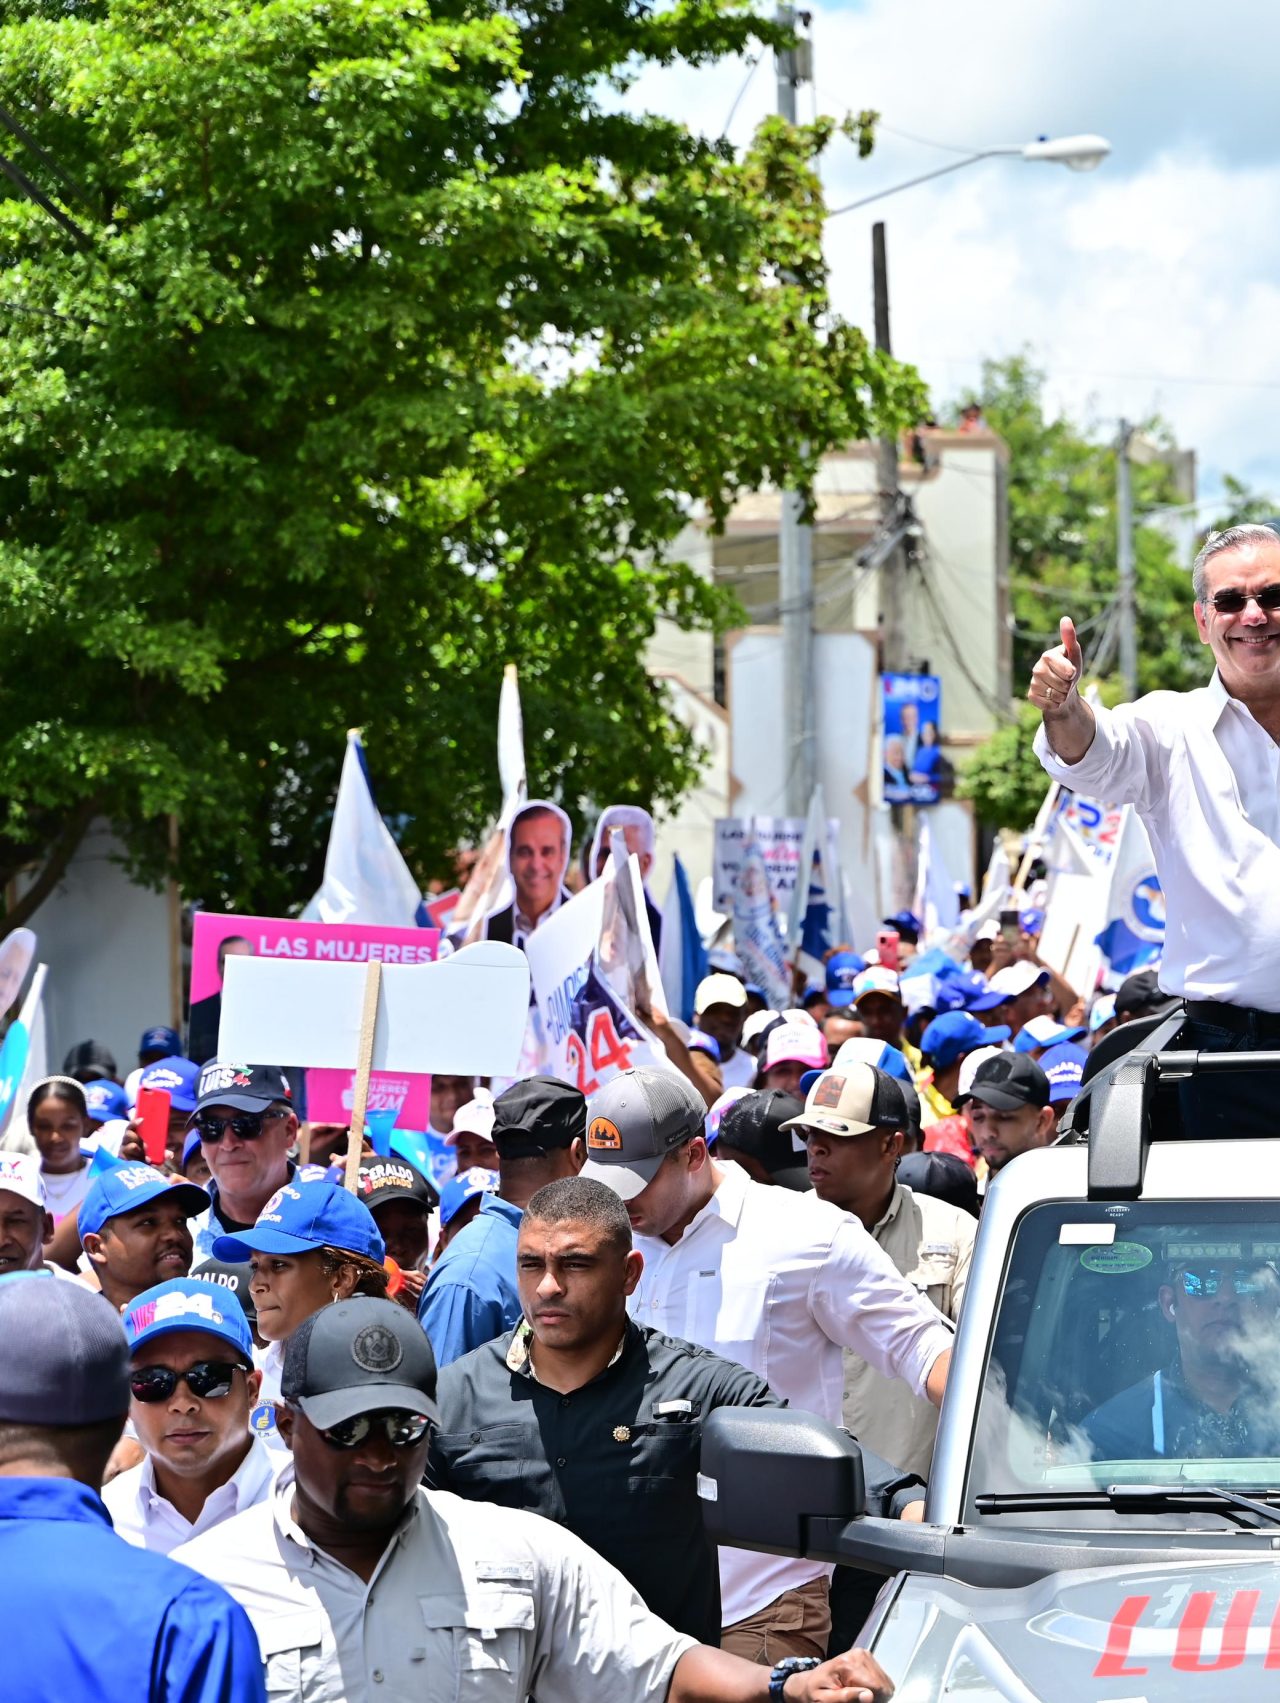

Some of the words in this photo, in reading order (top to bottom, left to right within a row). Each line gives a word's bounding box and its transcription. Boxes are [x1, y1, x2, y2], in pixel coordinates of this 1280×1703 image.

[259, 935, 309, 956] LAS
[315, 939, 433, 964] MUJERES
[198, 1069, 235, 1098] LUIS
[358, 1163, 414, 1189] GERALDO
